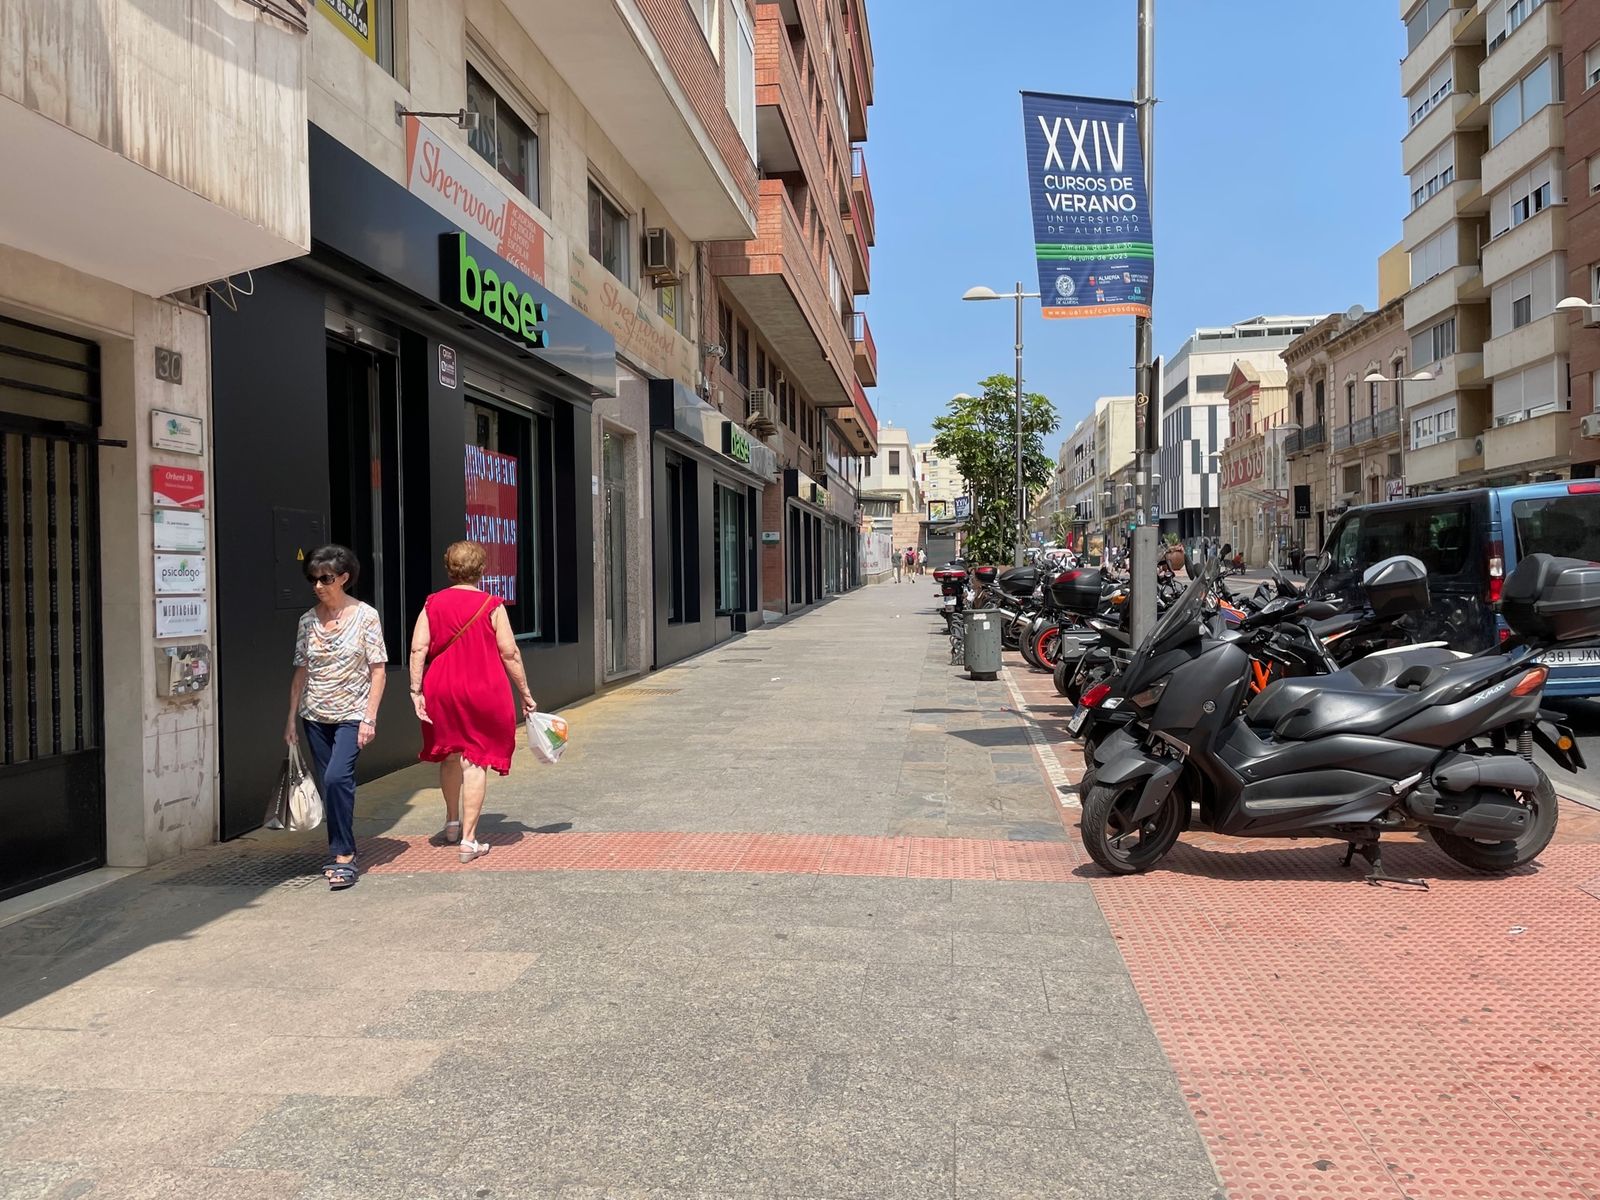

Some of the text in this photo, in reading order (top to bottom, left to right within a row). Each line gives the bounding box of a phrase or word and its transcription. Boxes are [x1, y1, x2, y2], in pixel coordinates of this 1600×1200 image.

[348, 8, 358, 28] 20
[358, 18, 368, 37] 30
[1038, 115, 1124, 173] XXIV
[419, 140, 506, 240] Sherwood
[1044, 175, 1134, 192] CURSOS DE
[1045, 193, 1137, 213] VERANO
[1046, 214, 1139, 225] UNIVERSIDAD
[1047, 223, 1140, 235] DE ALMERÍA
[1097, 253, 1107, 261] de
[159, 351, 181, 380] 30
[1540, 651, 1573, 663] 2381
